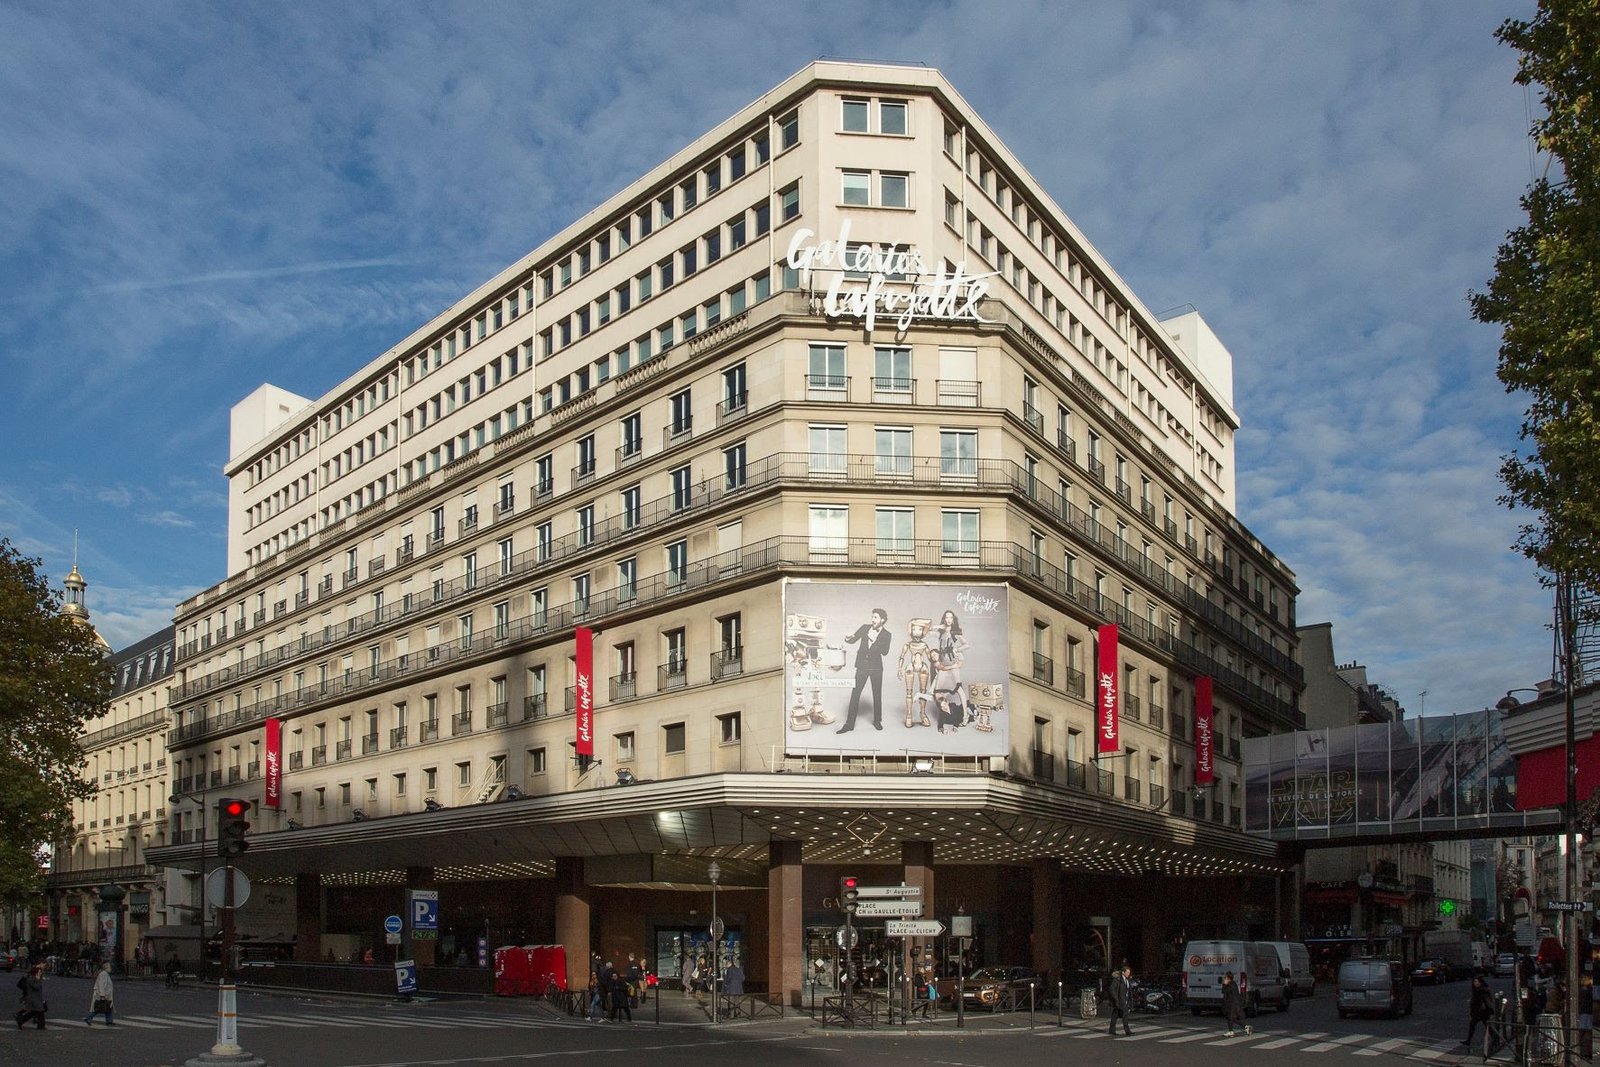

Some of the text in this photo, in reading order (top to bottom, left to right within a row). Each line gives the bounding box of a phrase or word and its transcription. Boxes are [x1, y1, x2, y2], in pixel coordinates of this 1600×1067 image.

[786, 218, 929, 284] Galeries
[824, 261, 1002, 332] Lafayette
[956, 590, 986, 604] Galeries
[965, 598, 1000, 614] Lafayette
[577, 672, 591, 741] Galeries Lafayette
[1100, 672, 1116, 739] Galeries Lafayette
[1271, 770, 1356, 796] STAR
[1271, 798, 1356, 821] WARS
[1202, 956, 1238, 964] Location
